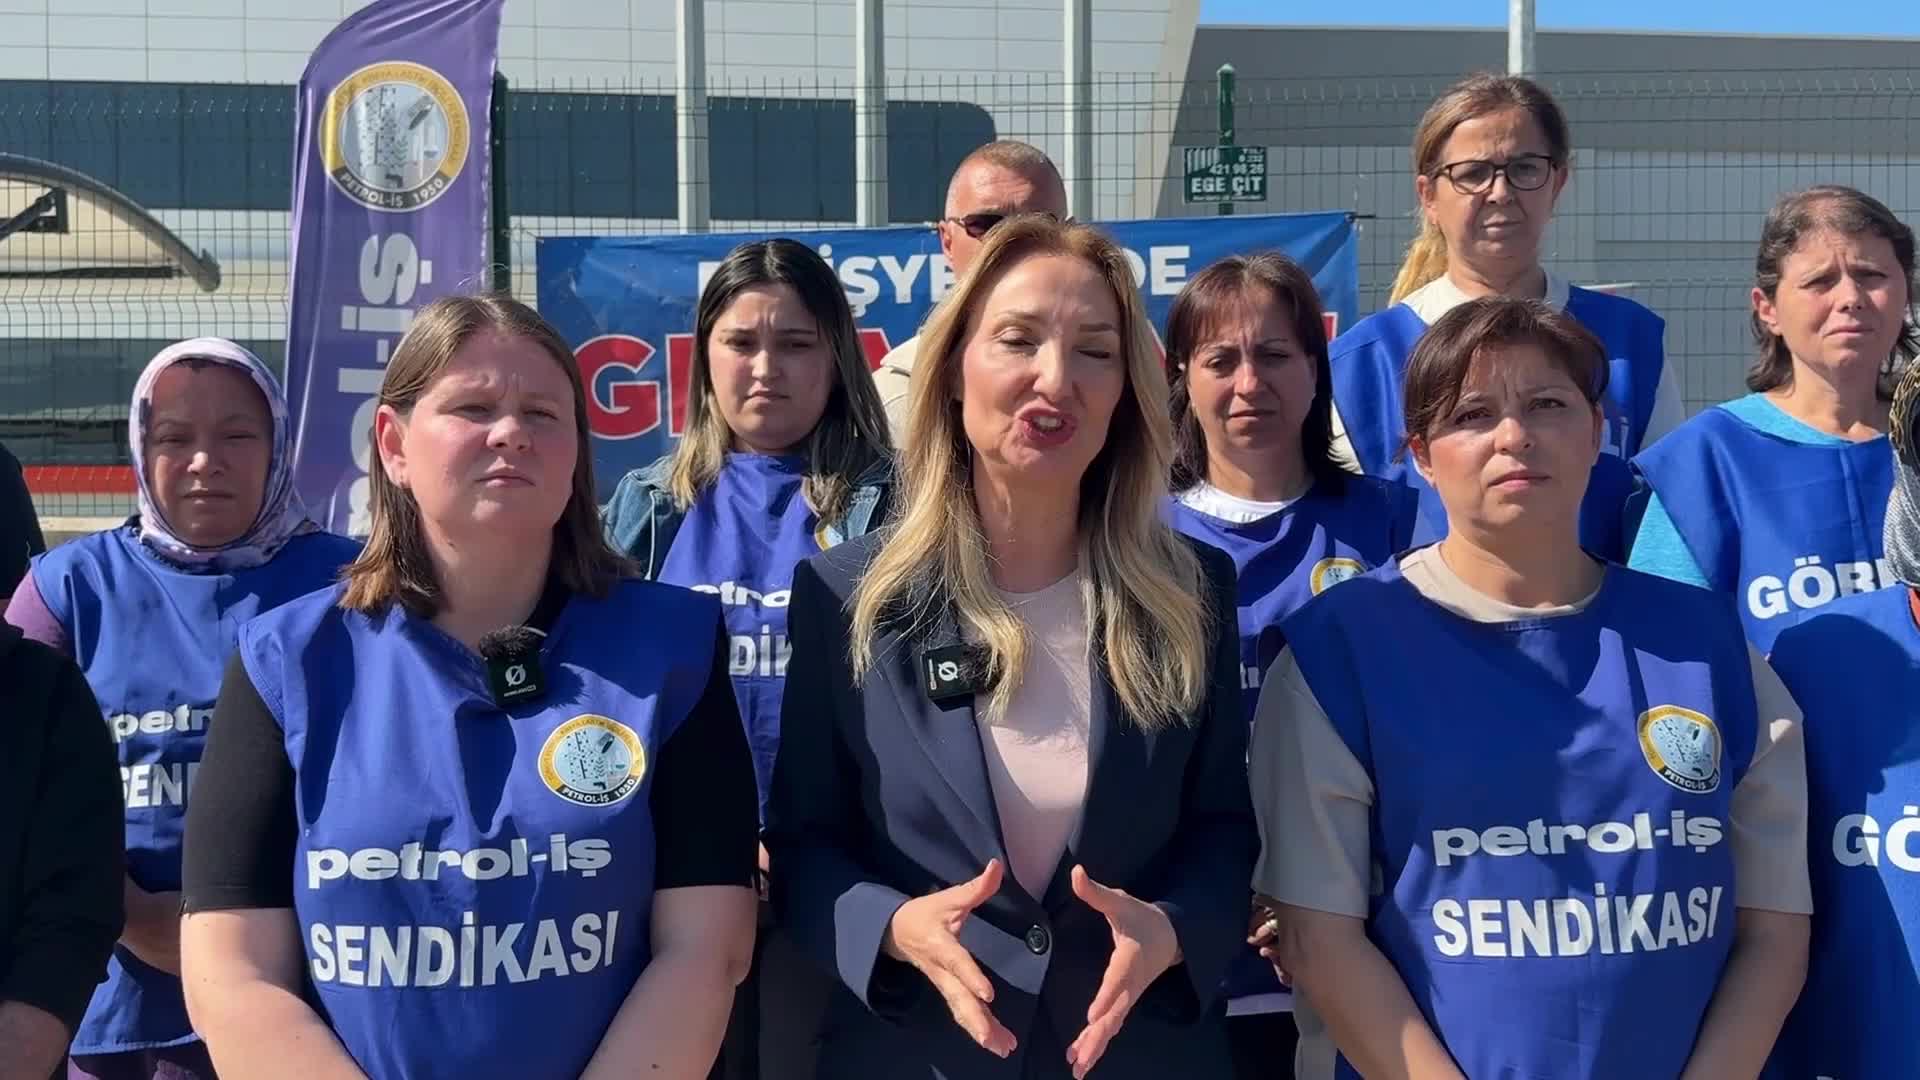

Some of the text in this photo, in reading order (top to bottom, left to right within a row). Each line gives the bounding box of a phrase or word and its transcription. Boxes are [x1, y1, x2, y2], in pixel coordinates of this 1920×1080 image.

[413, 178, 444, 203] 1950
[1191, 177, 1226, 193] EGE
[615, 778, 636, 797] 1950
[307, 834, 612, 889] petrol-iş
[1431, 810, 1723, 867] petrol-iş
[1432, 882, 1723, 958] SENDİKASI
[310, 910, 620, 988] SENDİKASI
